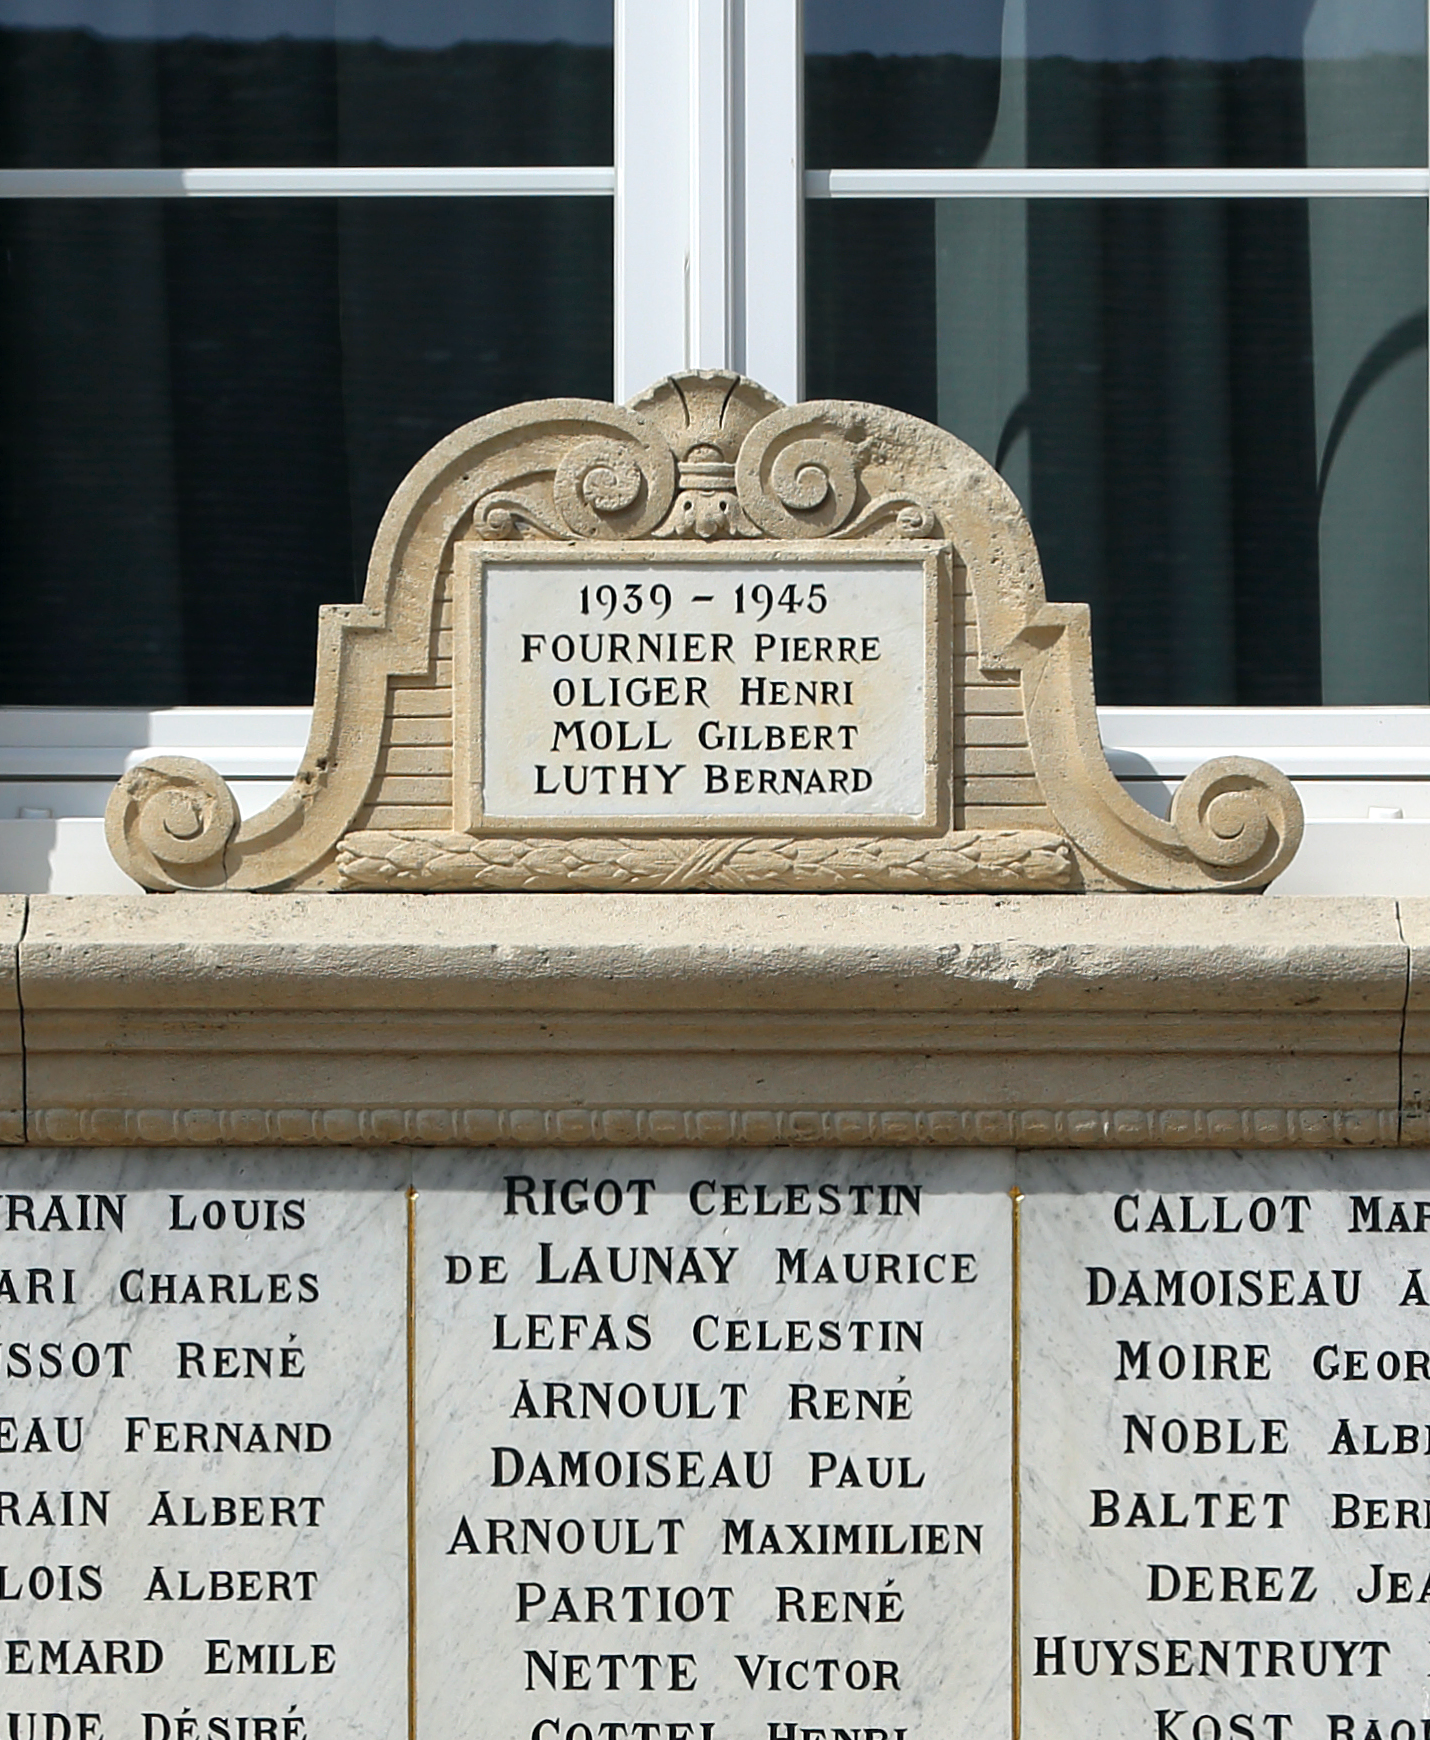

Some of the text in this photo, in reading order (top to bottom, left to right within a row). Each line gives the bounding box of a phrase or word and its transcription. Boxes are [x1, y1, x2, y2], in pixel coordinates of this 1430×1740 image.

[581, 583, 672, 619] 1939
[735, 583, 827, 622] 1945
[521, 633, 880, 664] FOURNIER PIERRE
[553, 676, 853, 708] OLIGER HENRI
[551, 720, 858, 752] MOLL GILBERT
[535, 764, 873, 795] LUTHY BERNARD
[168, 1194, 305, 1231] LOUIS
[503, 1175, 656, 1216] RIGOT
[1114, 1194, 1312, 1233] CALLOT
[536, 1242, 739, 1285] LAUNAY
[775, 1248, 978, 1284] MAURICE
[119, 1268, 319, 1305] CHARLES
[1085, 1266, 1362, 1307] DAMOISEAU
[492, 1314, 652, 1351] LEFAS
[176, 1333, 305, 1379] RENÉ
[1114, 1340, 1271, 1381] MOIRE
[510, 1375, 912, 1420] ARNOULT RENÉ
[125, 1416, 332, 1453] FERNAND
[1122, 1414, 1288, 1454] NOBLE
[490, 1446, 925, 1489] DAMOISEAU PAUL
[147, 1490, 325, 1527] ALBERT
[1089, 1489, 1290, 1529] BALTET
[446, 1515, 983, 1555] ARNOULT MAXIMILIEN
[143, 1566, 318, 1601] ALBERT
[516, 1578, 904, 1623] PARTIOT RENÉ
[1147, 1564, 1317, 1603] DEREZ
[204, 1639, 336, 1675] EMILE
[524, 1650, 901, 1691] NETTE VICTOR
[1033, 1635, 1391, 1678] HUYSENTRUYT
